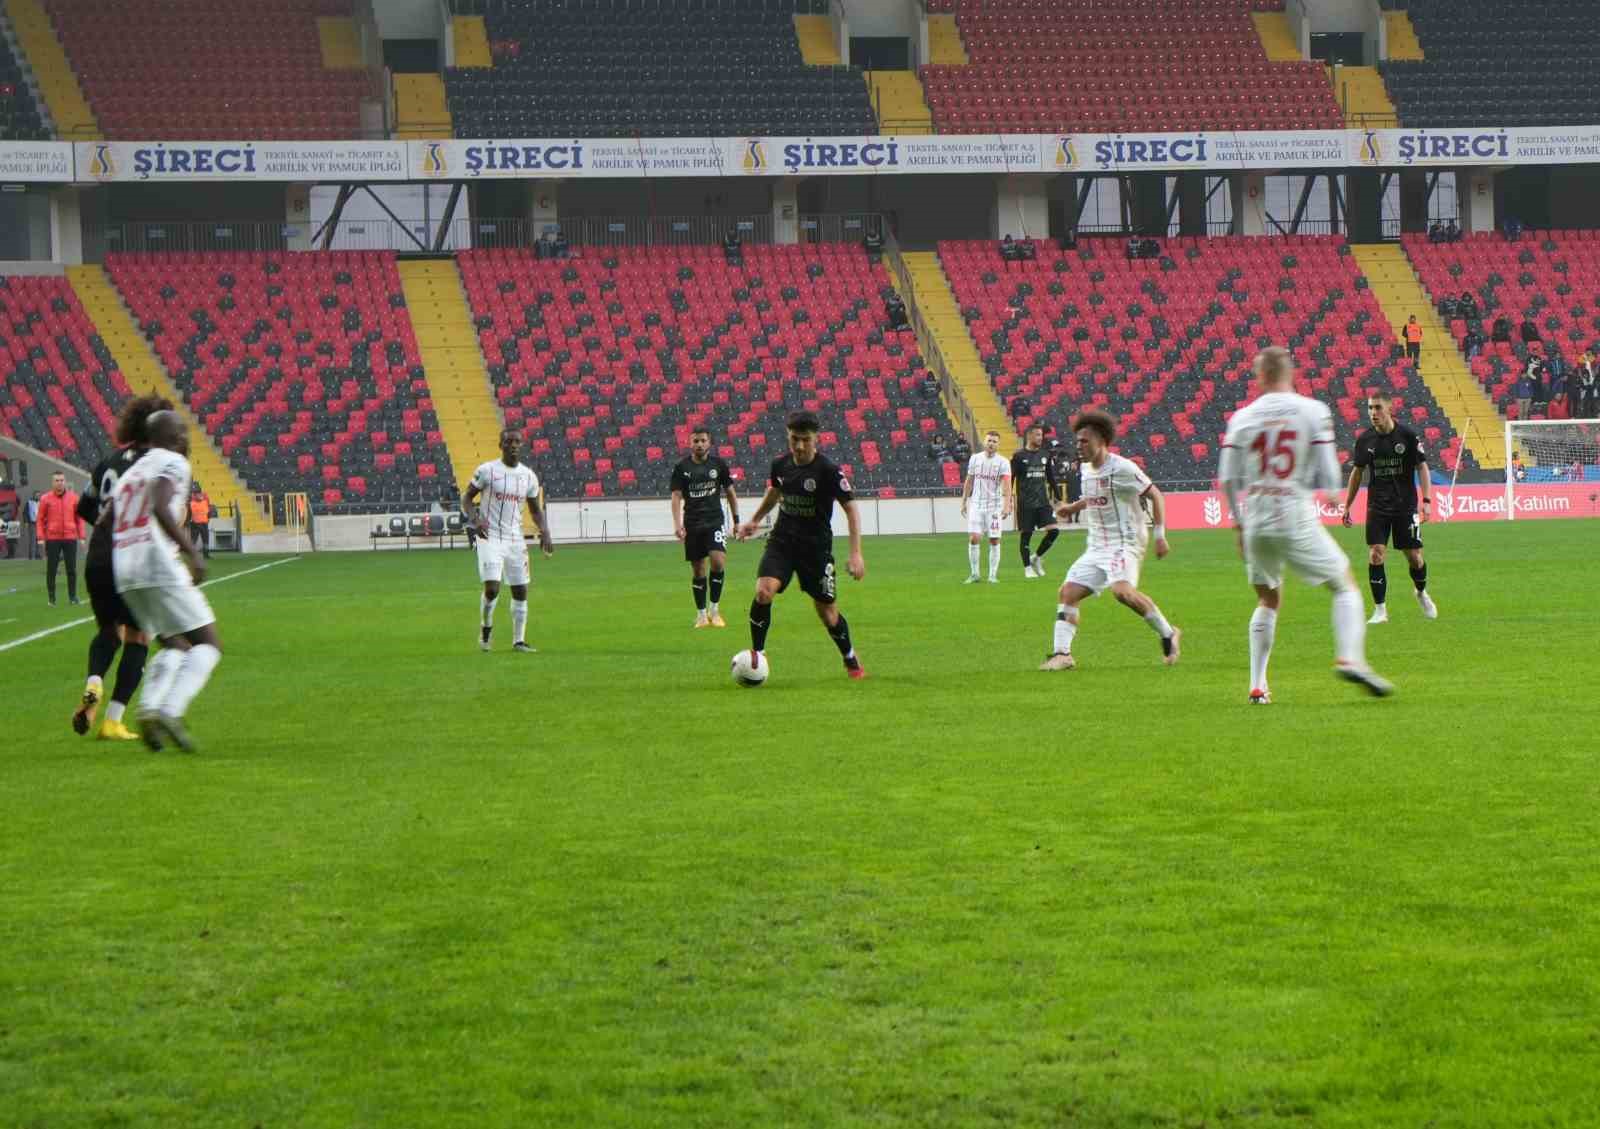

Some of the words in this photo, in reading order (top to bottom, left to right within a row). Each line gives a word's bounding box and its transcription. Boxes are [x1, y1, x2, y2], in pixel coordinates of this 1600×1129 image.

[134, 143, 256, 179] ŞİRECİ
[465, 140, 583, 176] ŞİRECİ
[653, 159, 690, 168] PAMUK
[784, 137, 898, 173] ŞİRECİ
[967, 155, 1002, 164] PAMUK
[1095, 134, 1207, 169] ŞİRECİ
[1273, 151, 1309, 160] PAMUK
[1399, 129, 1508, 164] ŞİRECİ
[1558, 146, 1571, 156] VE
[329, 162, 367, 172] PAMUK
[1250, 430, 1297, 479] 15
[115, 479, 150, 533] 22
